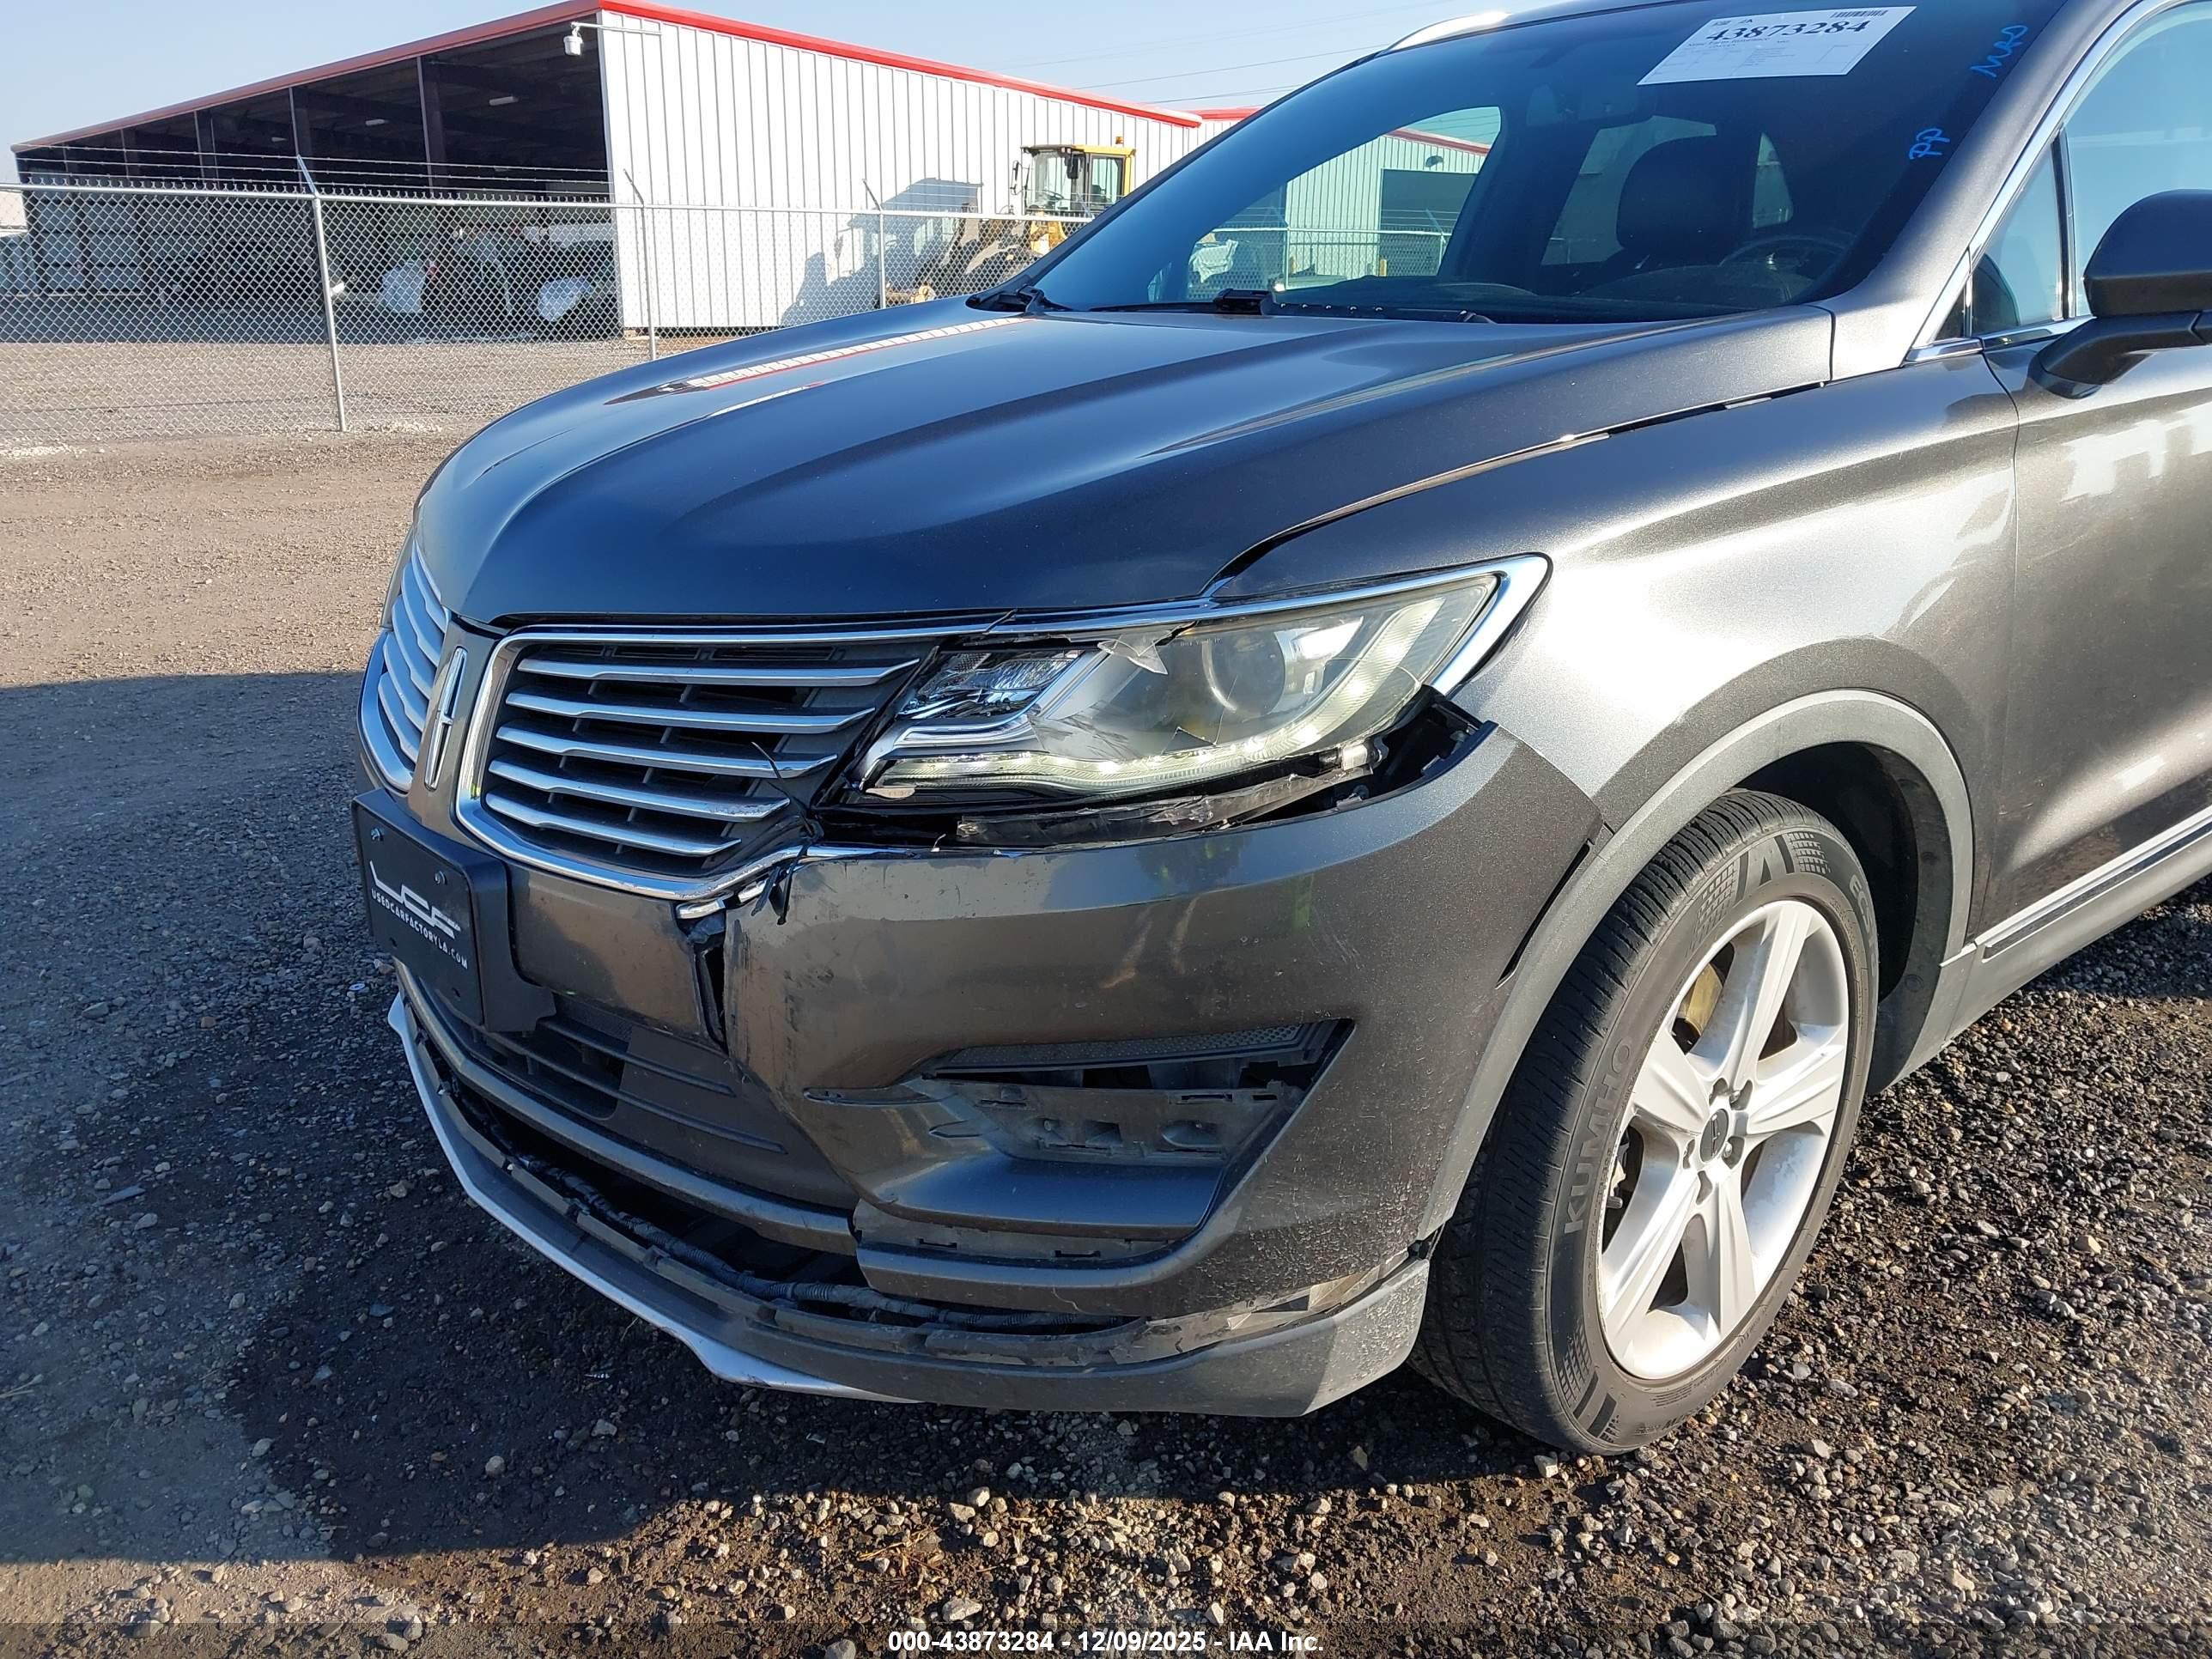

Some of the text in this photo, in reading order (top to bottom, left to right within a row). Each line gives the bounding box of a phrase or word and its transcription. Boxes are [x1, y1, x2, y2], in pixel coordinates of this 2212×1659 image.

[1705, 19, 1872, 41] 43873284
[371, 887, 468, 969] USEDCARFACTORYLA.COM
[1564, 1037, 1631, 1234] KUMHO
